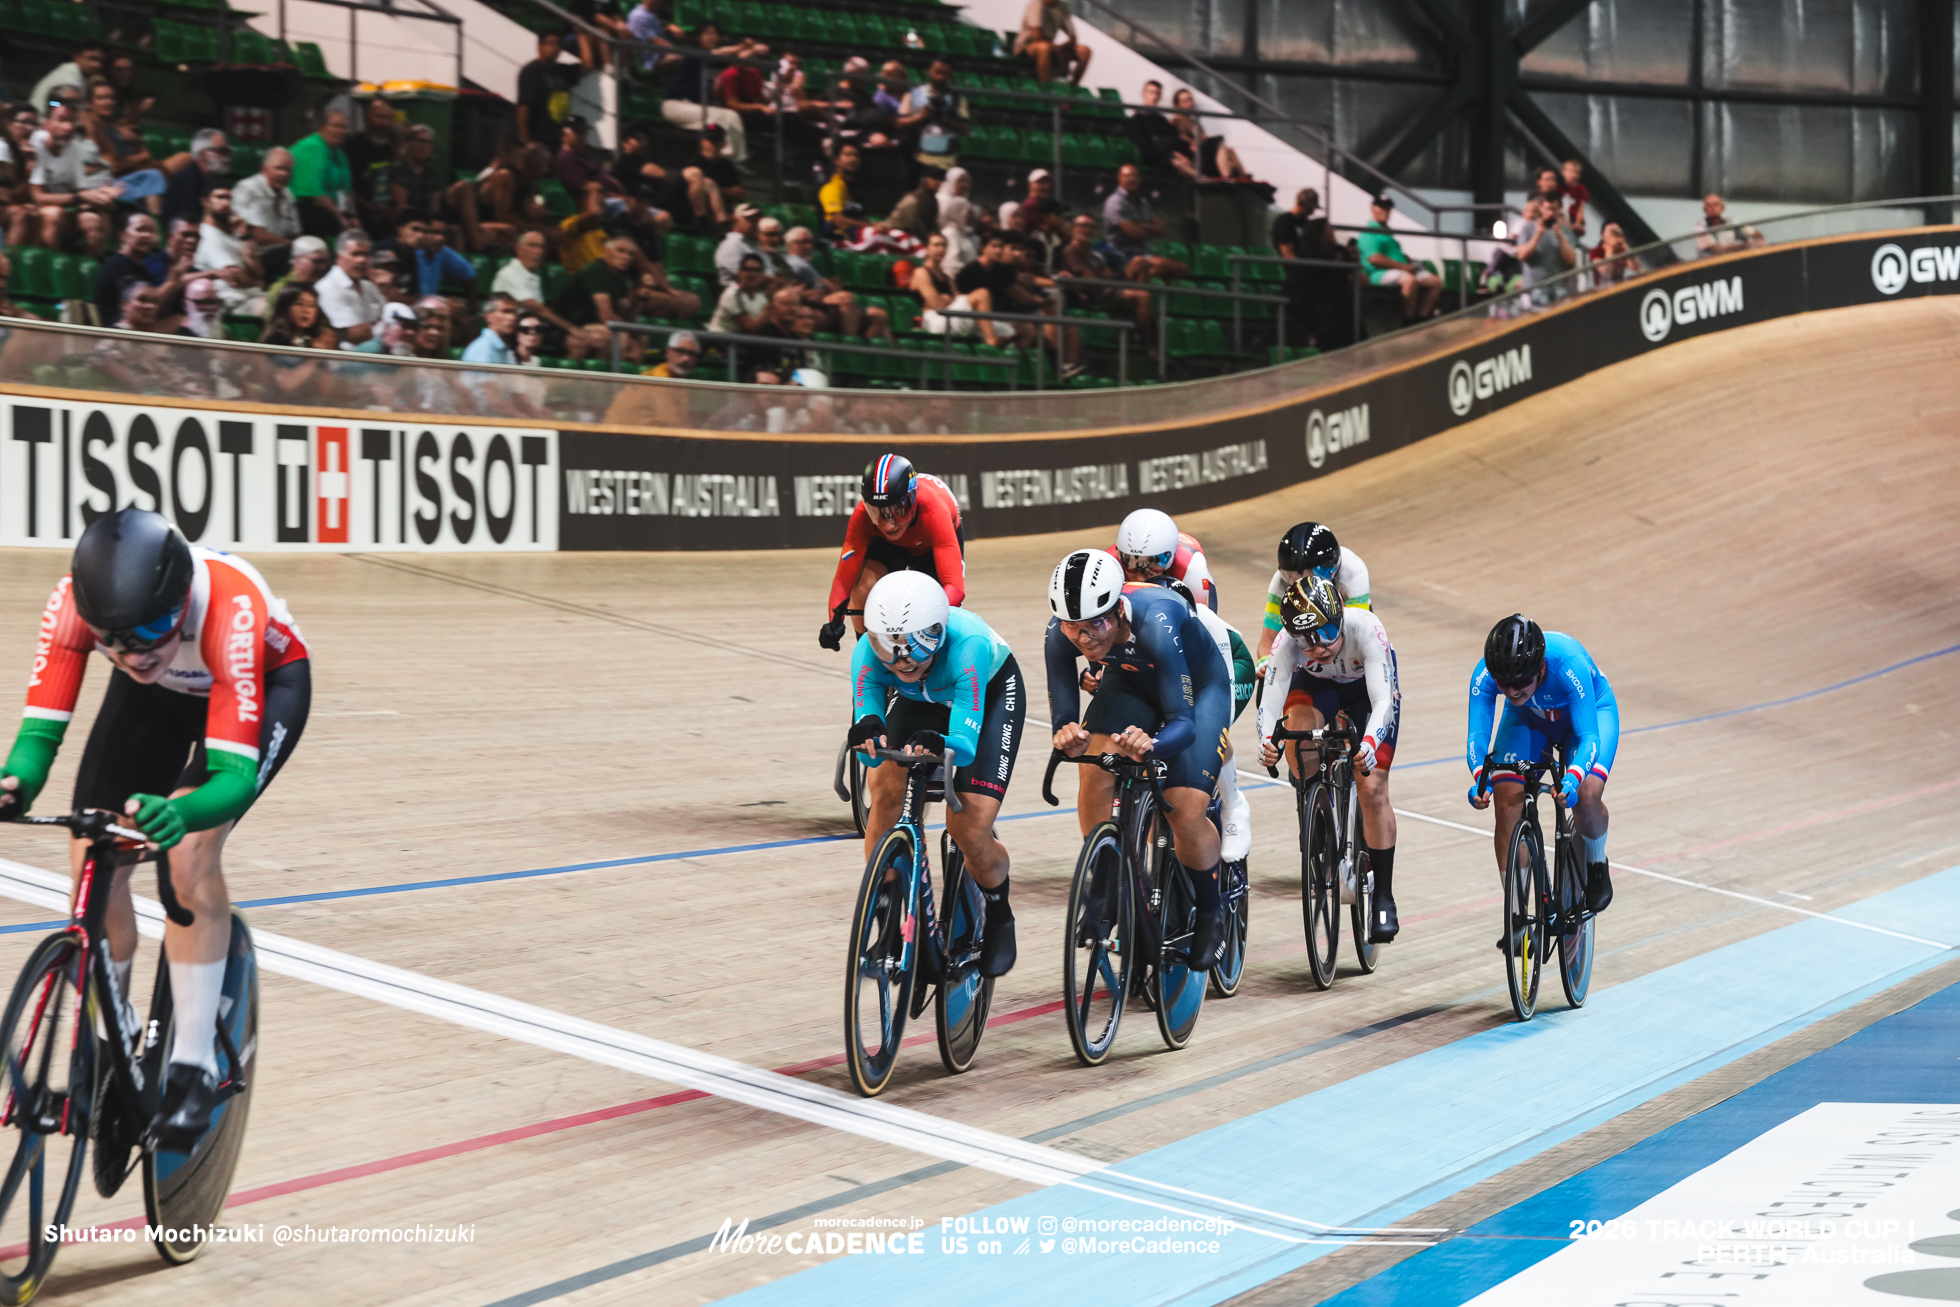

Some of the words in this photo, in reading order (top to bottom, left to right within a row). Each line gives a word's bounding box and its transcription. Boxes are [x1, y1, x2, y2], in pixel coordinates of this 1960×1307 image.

[1910, 246, 1960, 283] GW
[1673, 277, 1744, 325] GWM
[1473, 344, 1532, 399] GWM
[1326, 403, 1370, 453] GWM
[12, 405, 254, 543] TISSOT
[361, 428, 548, 544] TISSOT
[566, 469, 669, 515] WESTERN
[672, 474, 780, 517] AUSTRALIA
[981, 469, 1053, 509] WESTERN
[1054, 463, 1129, 504] AUSTRALIA
[1139, 454, 1200, 494] WESTERN
[1202, 439, 1268, 483] AUSTRALIA
[794, 475, 863, 517] WESTE
[28, 574, 72, 687] PORTUGA
[228, 594, 259, 724] PORTUGAL
[1180, 674, 1195, 707] ESP
[996, 755, 1010, 782] HONG
[1005, 674, 1017, 712] CHINA
[1754, 1153, 1937, 1219] WATCHES
